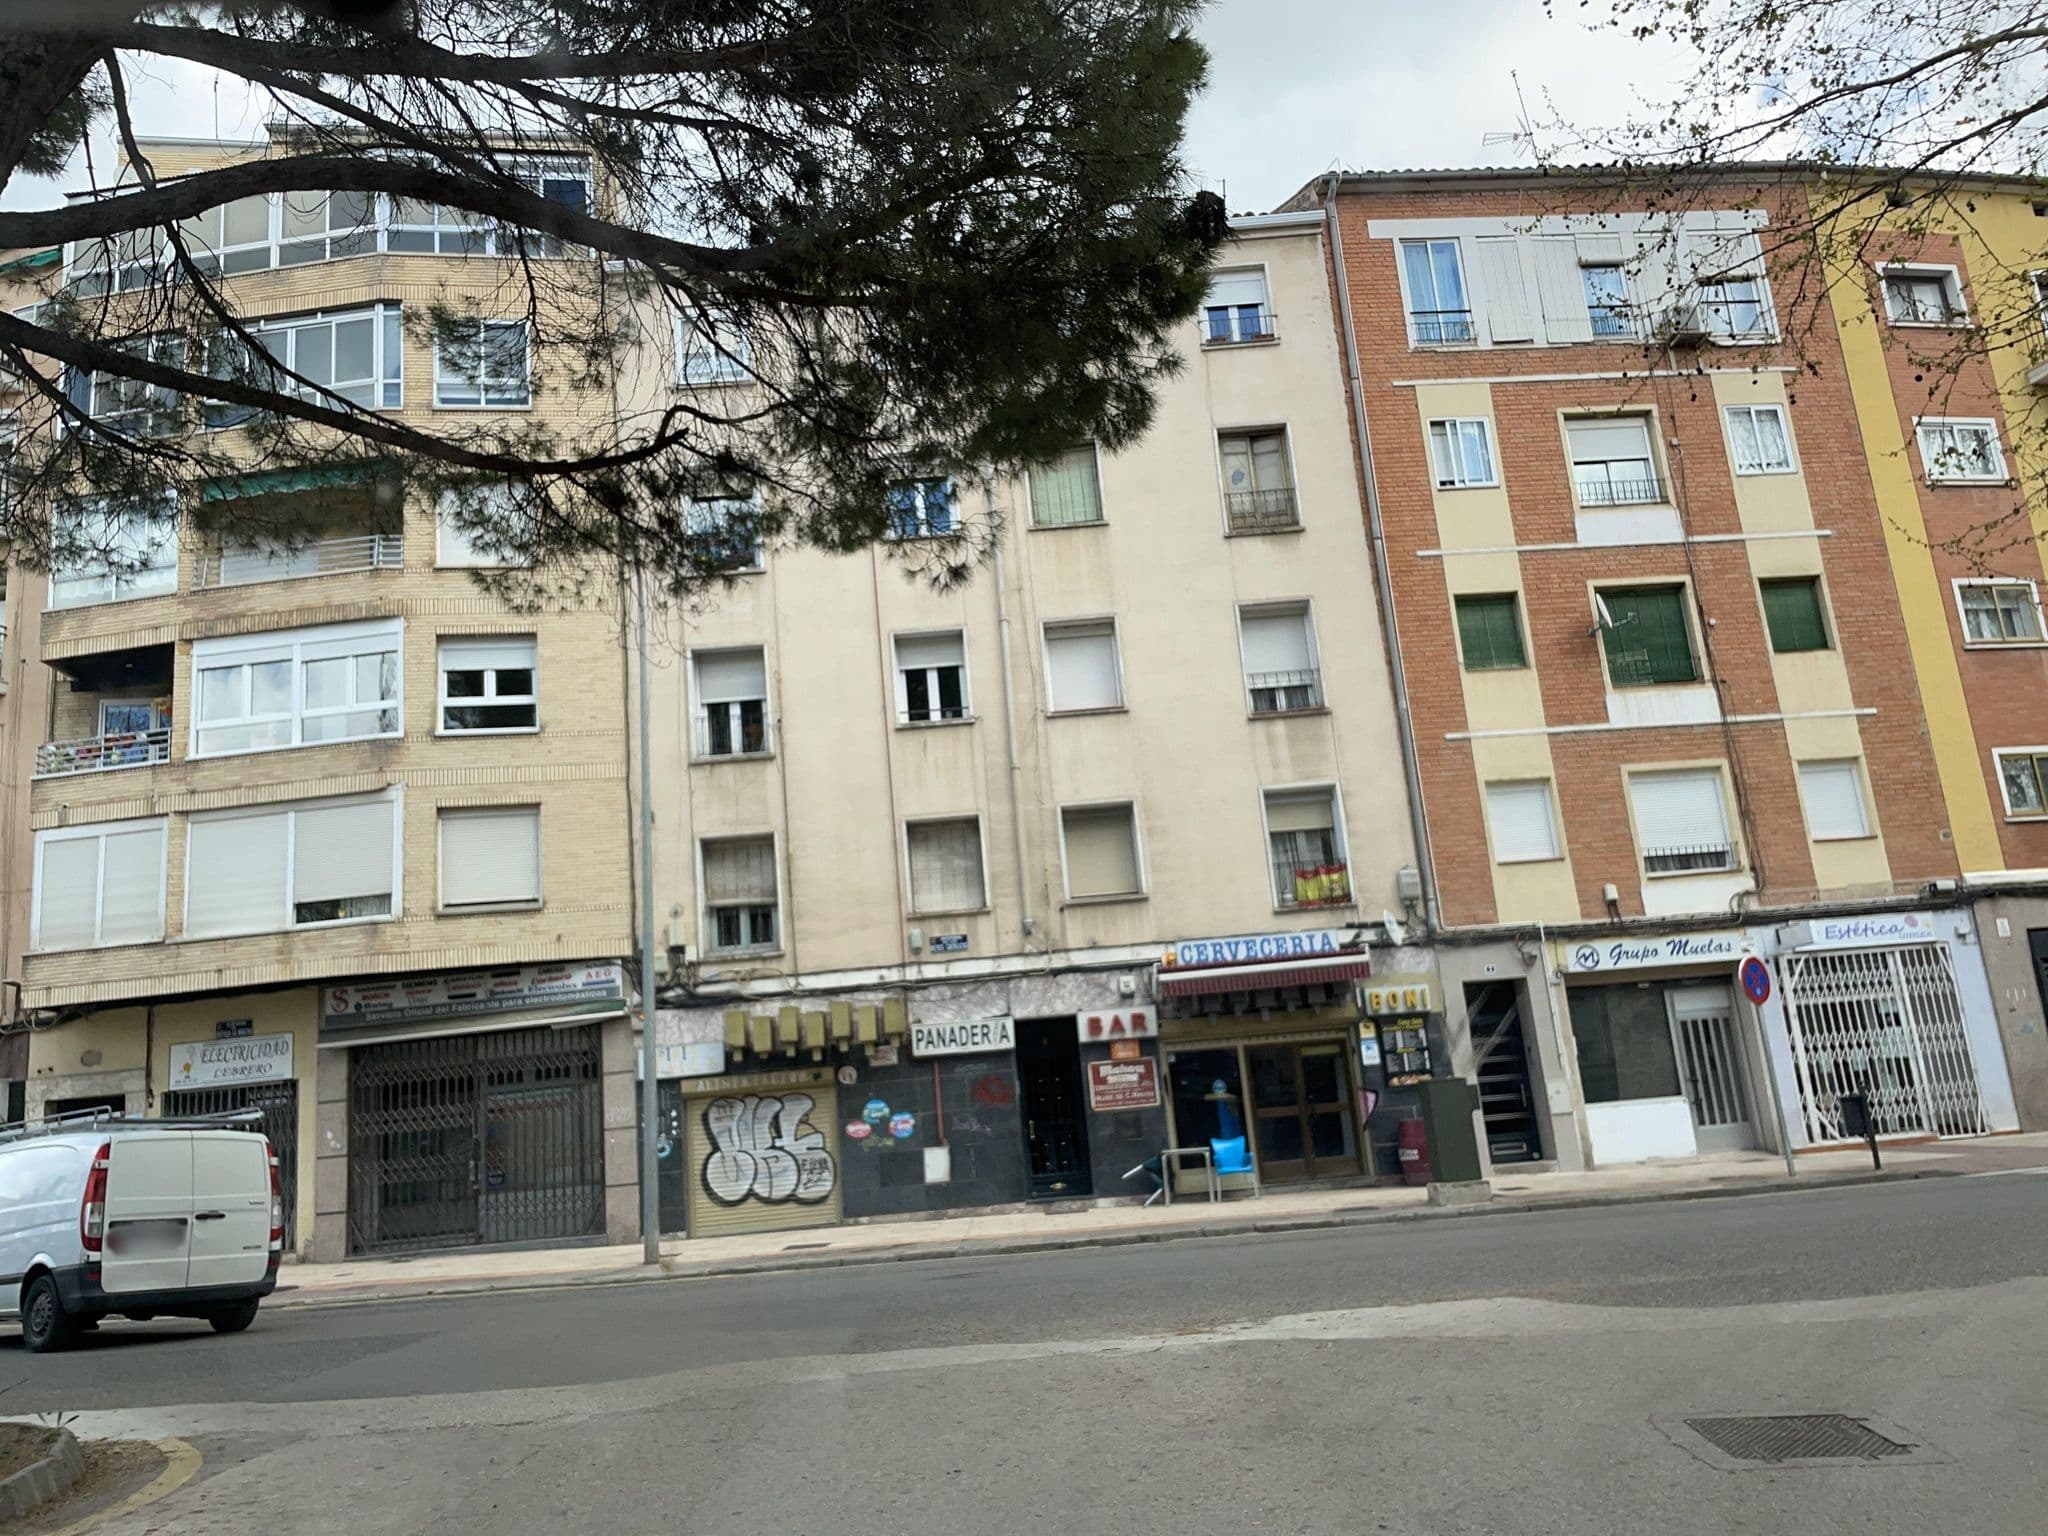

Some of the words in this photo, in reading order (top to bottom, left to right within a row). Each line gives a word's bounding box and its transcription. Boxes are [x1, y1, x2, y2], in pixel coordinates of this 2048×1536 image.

[1825, 920, 1903, 940] Estética
[1609, 943, 1658, 966] Grupo
[1666, 937, 1733, 957] Muelas
[502, 999, 523, 1010] para
[1370, 989, 1428, 1012] BONI
[1087, 1013, 1147, 1036] BAR
[201, 1040, 289, 1064] ELECTRICIDAD
